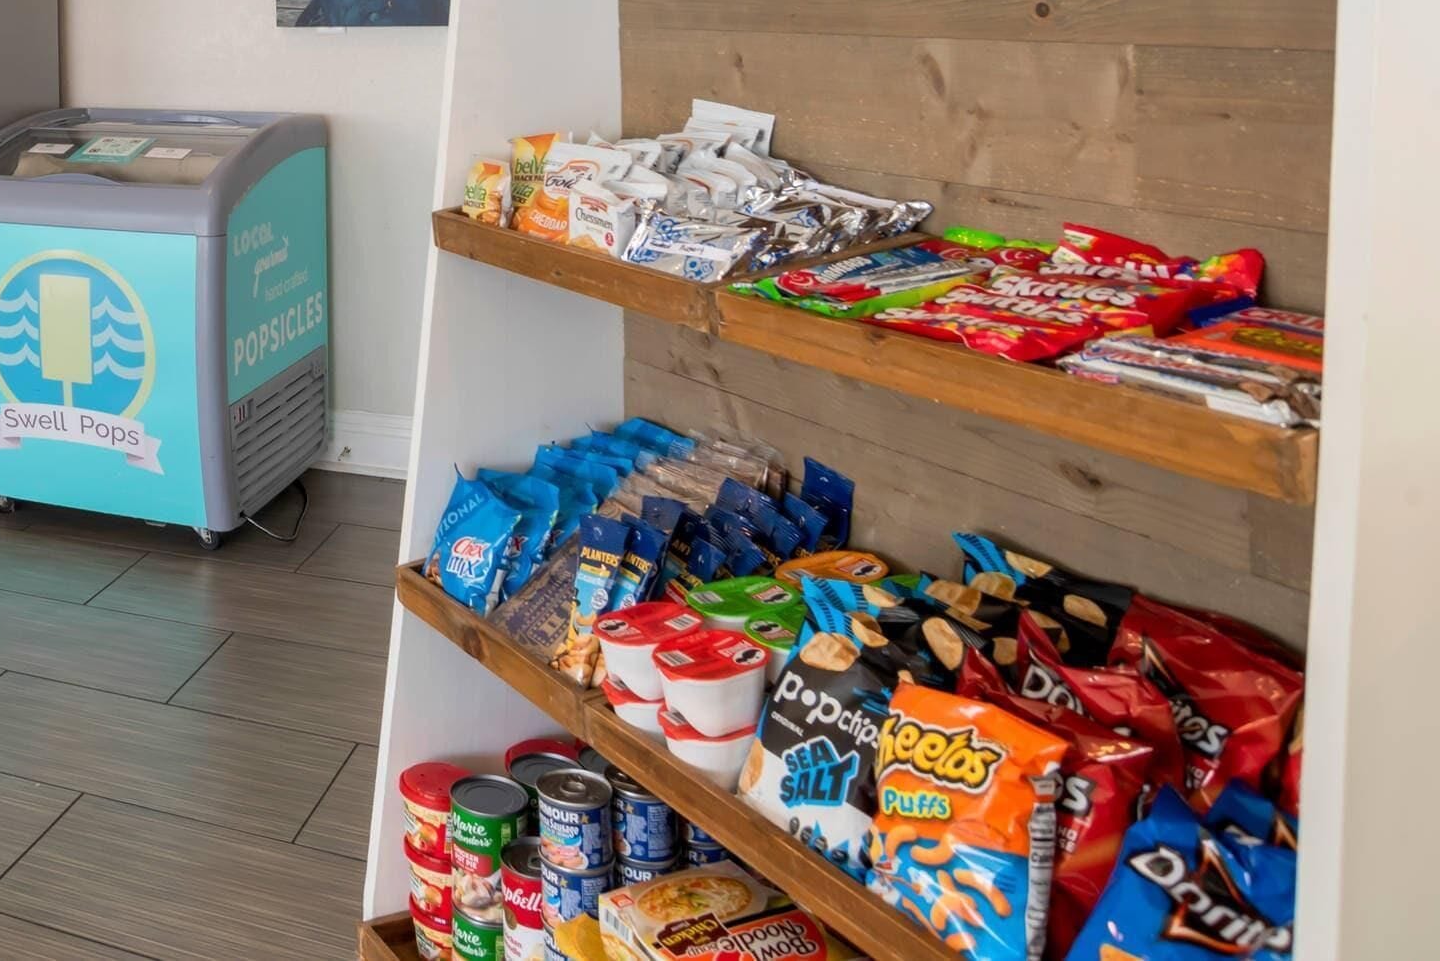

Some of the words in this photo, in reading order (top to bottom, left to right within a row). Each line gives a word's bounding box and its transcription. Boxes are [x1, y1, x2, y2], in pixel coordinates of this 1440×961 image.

[515, 153, 545, 175] belVi
[528, 208, 569, 232] CHEDDAR
[574, 206, 614, 231] Chessmen
[233, 221, 274, 258] LOCAL
[990, 274, 1138, 308] Skittles
[233, 290, 324, 377] POPSICLES
[4, 408, 68, 432] Swell
[80, 415, 140, 447] Pops
[581, 546, 620, 568] PLANTERS
[770, 710, 805, 737] ORIGINAL
[784, 738, 834, 773] SEA
[875, 714, 1003, 789] heetos
[779, 753, 857, 805] SALT
[883, 789, 952, 819] Puffs
[453, 811, 487, 837] Marie
[660, 919, 719, 946] Chicken
[719, 920, 806, 953] Noodle
